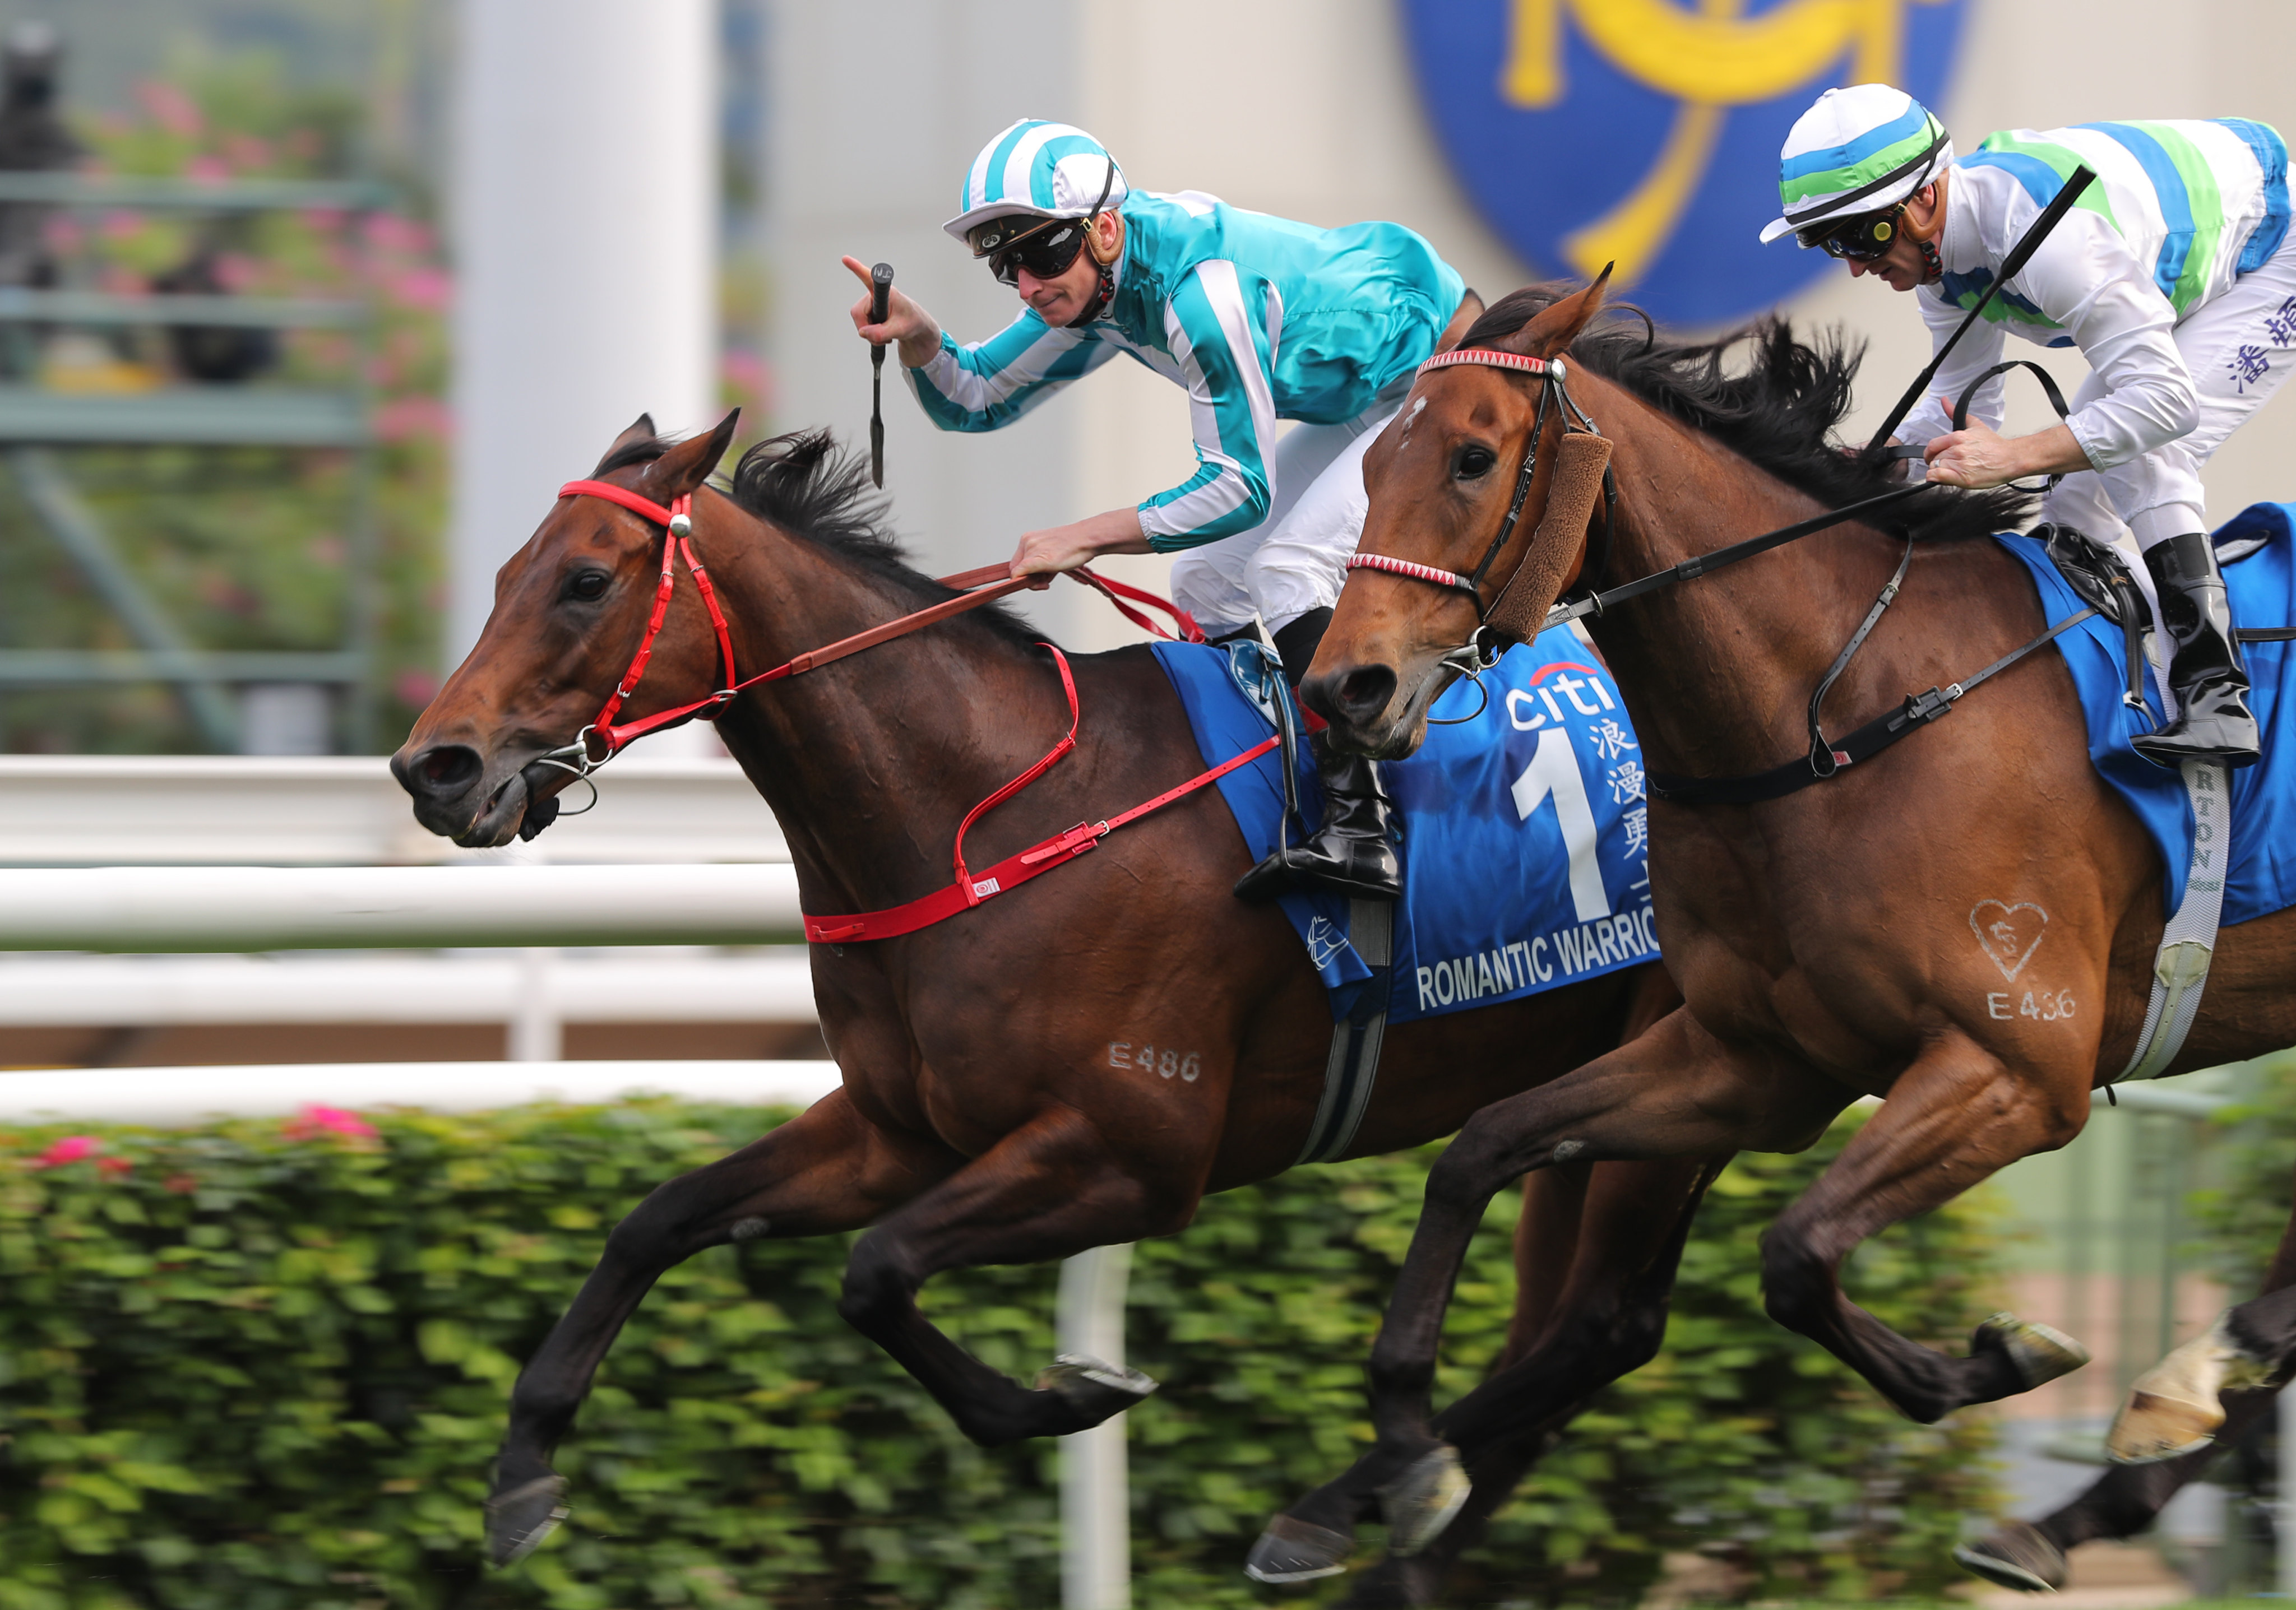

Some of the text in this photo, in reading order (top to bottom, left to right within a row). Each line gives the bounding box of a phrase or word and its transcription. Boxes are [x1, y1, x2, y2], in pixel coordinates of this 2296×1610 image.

[1506, 672, 1615, 731] citi
[1511, 726, 1612, 922] 1
[1417, 936, 1553, 1011] ROMANTIC
